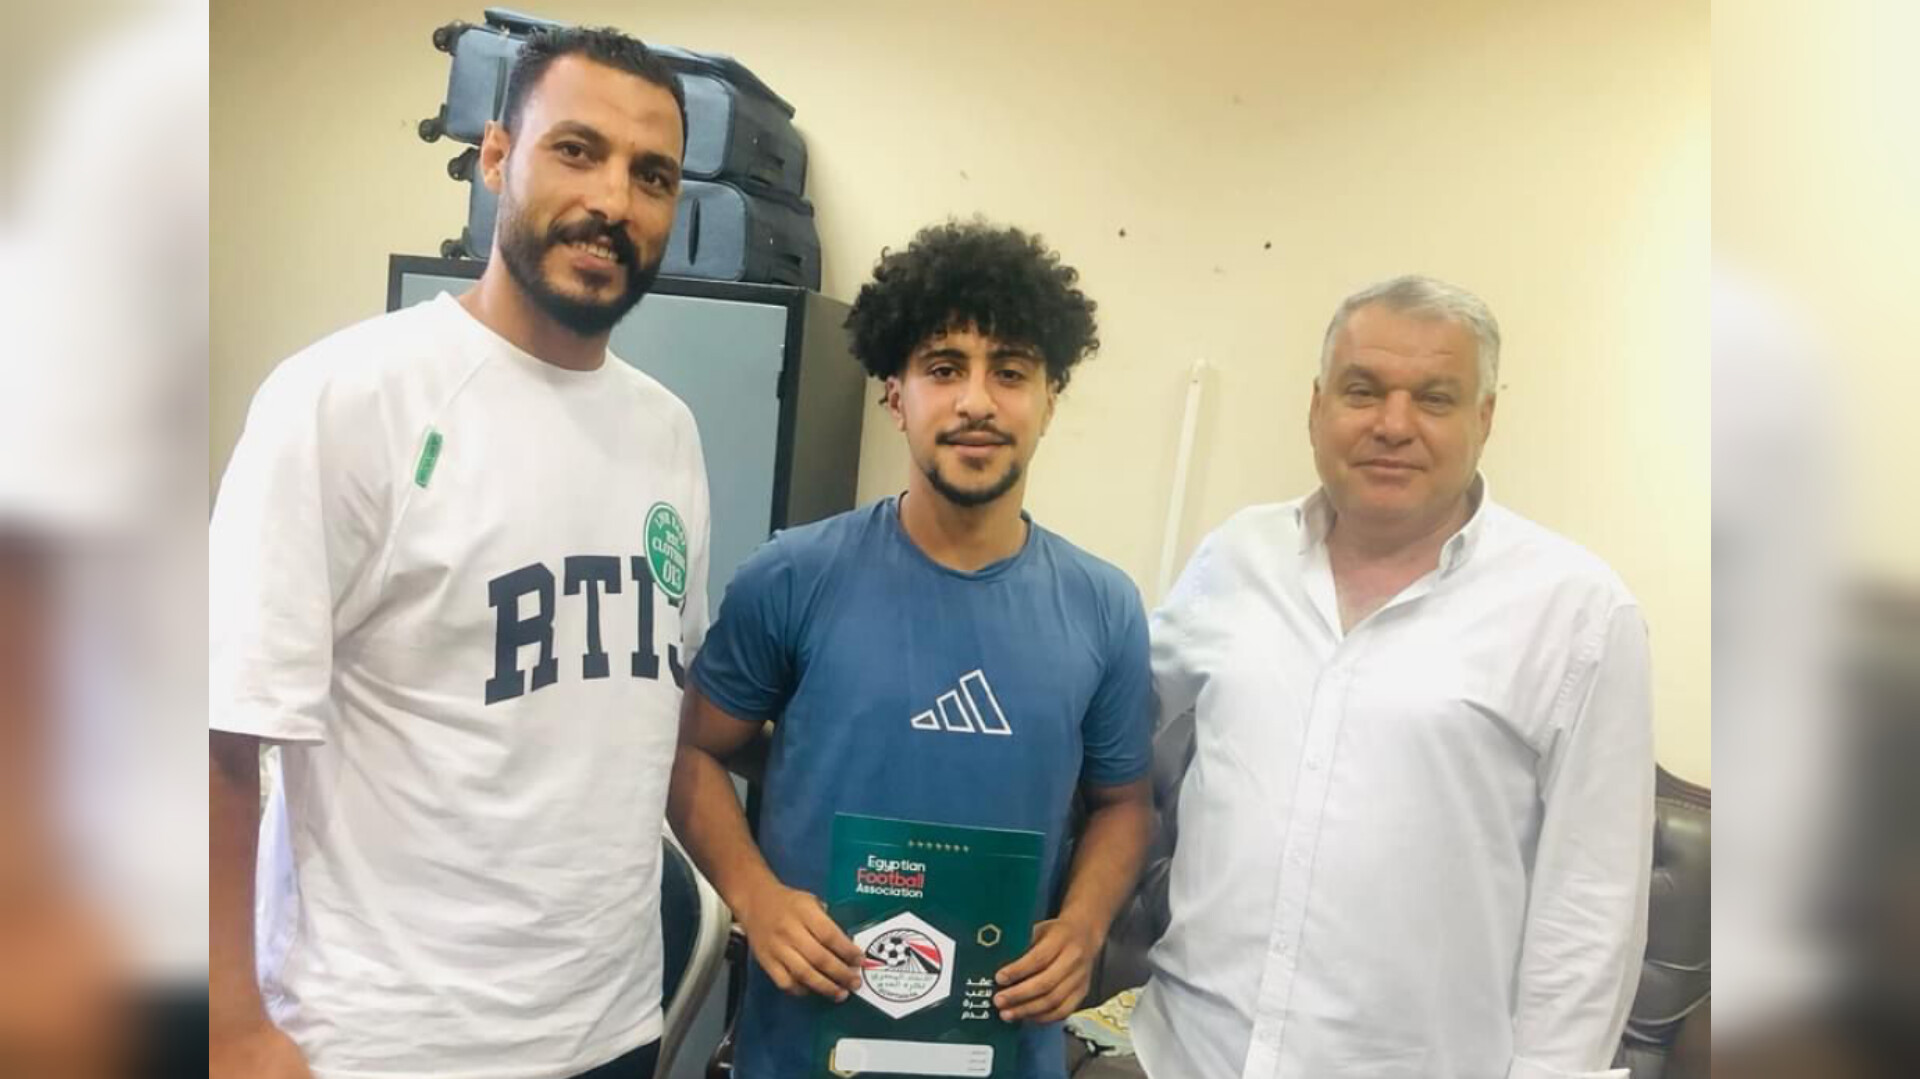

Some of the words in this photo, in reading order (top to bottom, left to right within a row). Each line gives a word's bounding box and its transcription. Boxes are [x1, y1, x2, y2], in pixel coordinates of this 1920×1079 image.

[867, 854, 926, 872] Egyptian
[857, 868, 925, 889] Football
[855, 883, 924, 898] Association
[964, 988, 993, 999] لاعب
[961, 1010, 990, 1020] قدم
